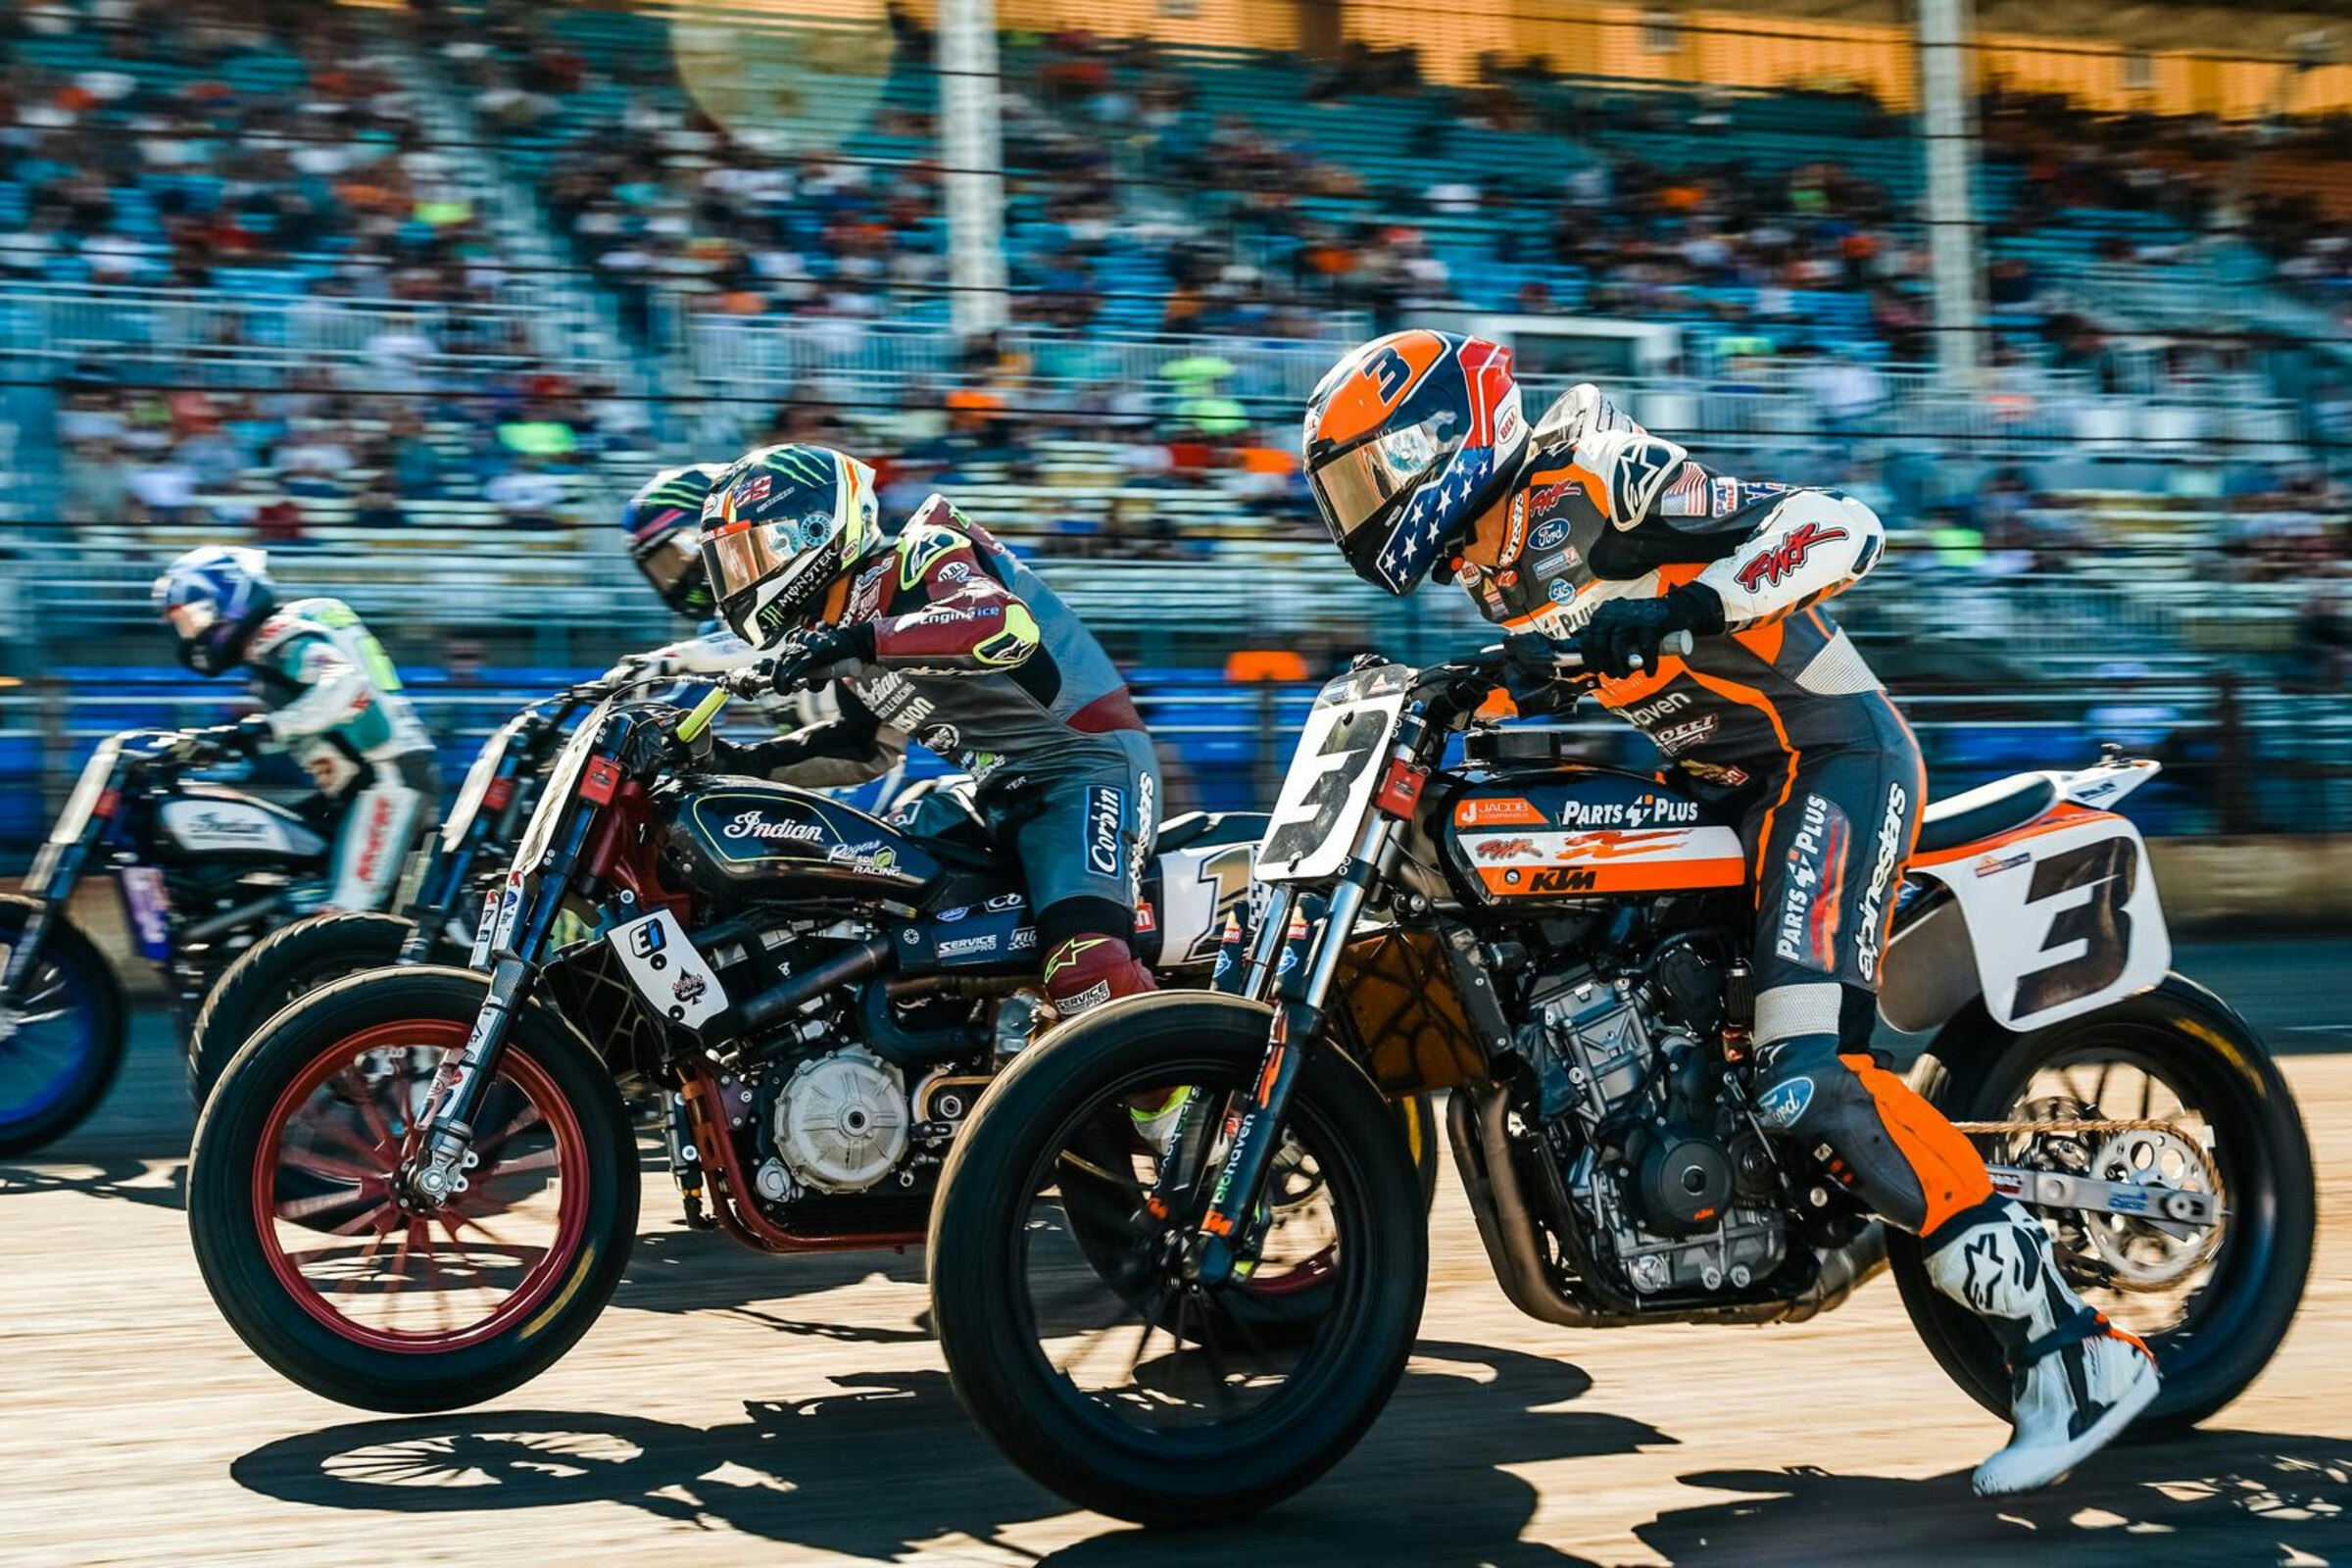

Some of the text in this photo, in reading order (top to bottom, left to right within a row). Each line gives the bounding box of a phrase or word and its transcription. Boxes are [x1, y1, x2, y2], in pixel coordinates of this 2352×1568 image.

[1360, 345, 1412, 407] 3
[1499, 412, 1516, 440] BELL
[1537, 520, 1565, 548] Ford
[778, 548, 839, 608] MONSTER
[1258, 710, 1389, 864] 3
[1479, 802, 1530, 813] JACOB
[1561, 798, 1698, 825] PARTS PLUS
[723, 810, 822, 842] Indian
[1090, 788, 1119, 873] Corbin
[853, 865, 902, 877] RACING
[1529, 866, 1597, 893] KTM
[1776, 794, 1828, 961] PARTS PLUS
[1855, 781, 1907, 982] alpinestars
[1181, 843, 1255, 962] 1
[938, 934, 998, 954] SERVICE
[2009, 836, 2138, 1022] 3
[1055, 981, 1109, 1010] SERVICE
